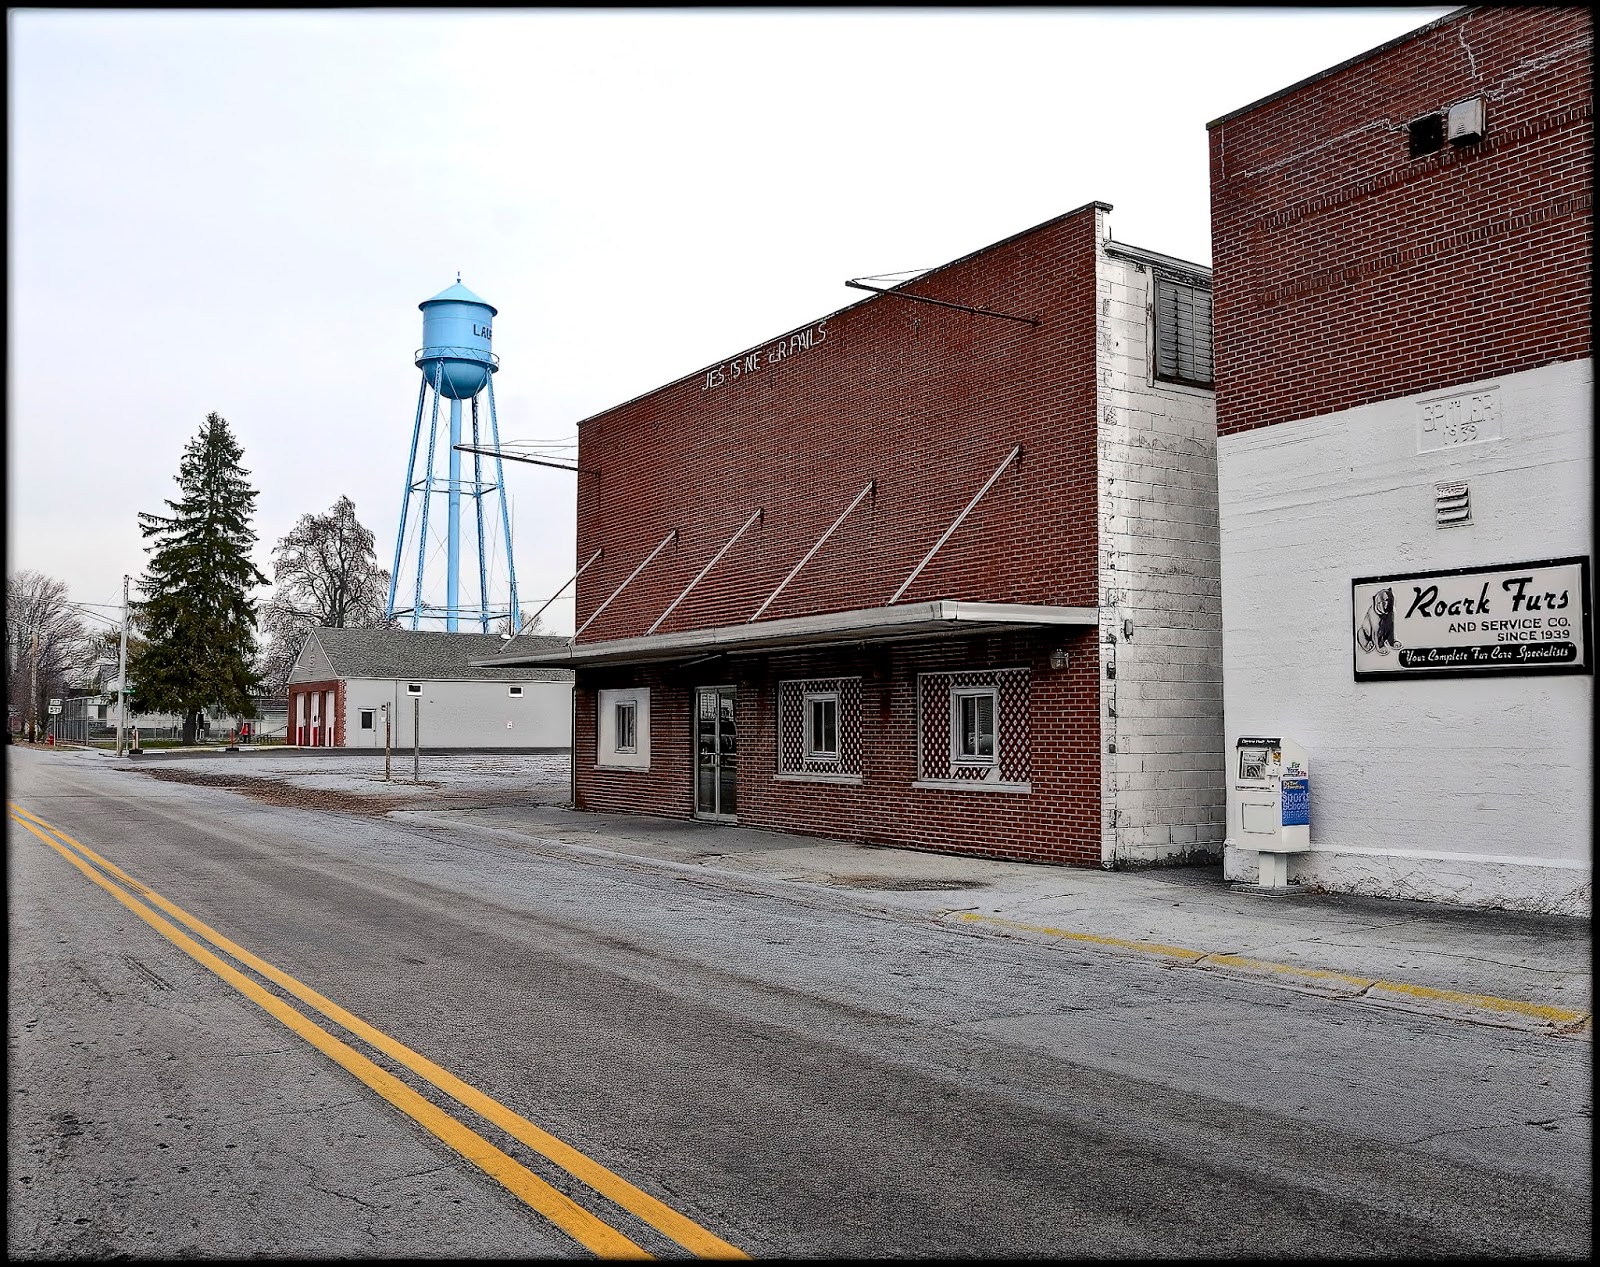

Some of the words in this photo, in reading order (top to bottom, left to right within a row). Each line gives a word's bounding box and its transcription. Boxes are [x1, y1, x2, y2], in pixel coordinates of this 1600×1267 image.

[1404, 581, 1491, 619] Roark
[1502, 577, 1569, 612] Furs
[1448, 621, 1476, 633] AND
[1481, 618, 1542, 631] SERVICE
[1547, 617, 1571, 627] CO.
[1497, 631, 1537, 642] SINCE
[1541, 630, 1570, 640] 1939
[1428, 649, 1468, 664] Complete
[1471, 647, 1489, 661] Fur
[1491, 647, 1512, 660] Care
